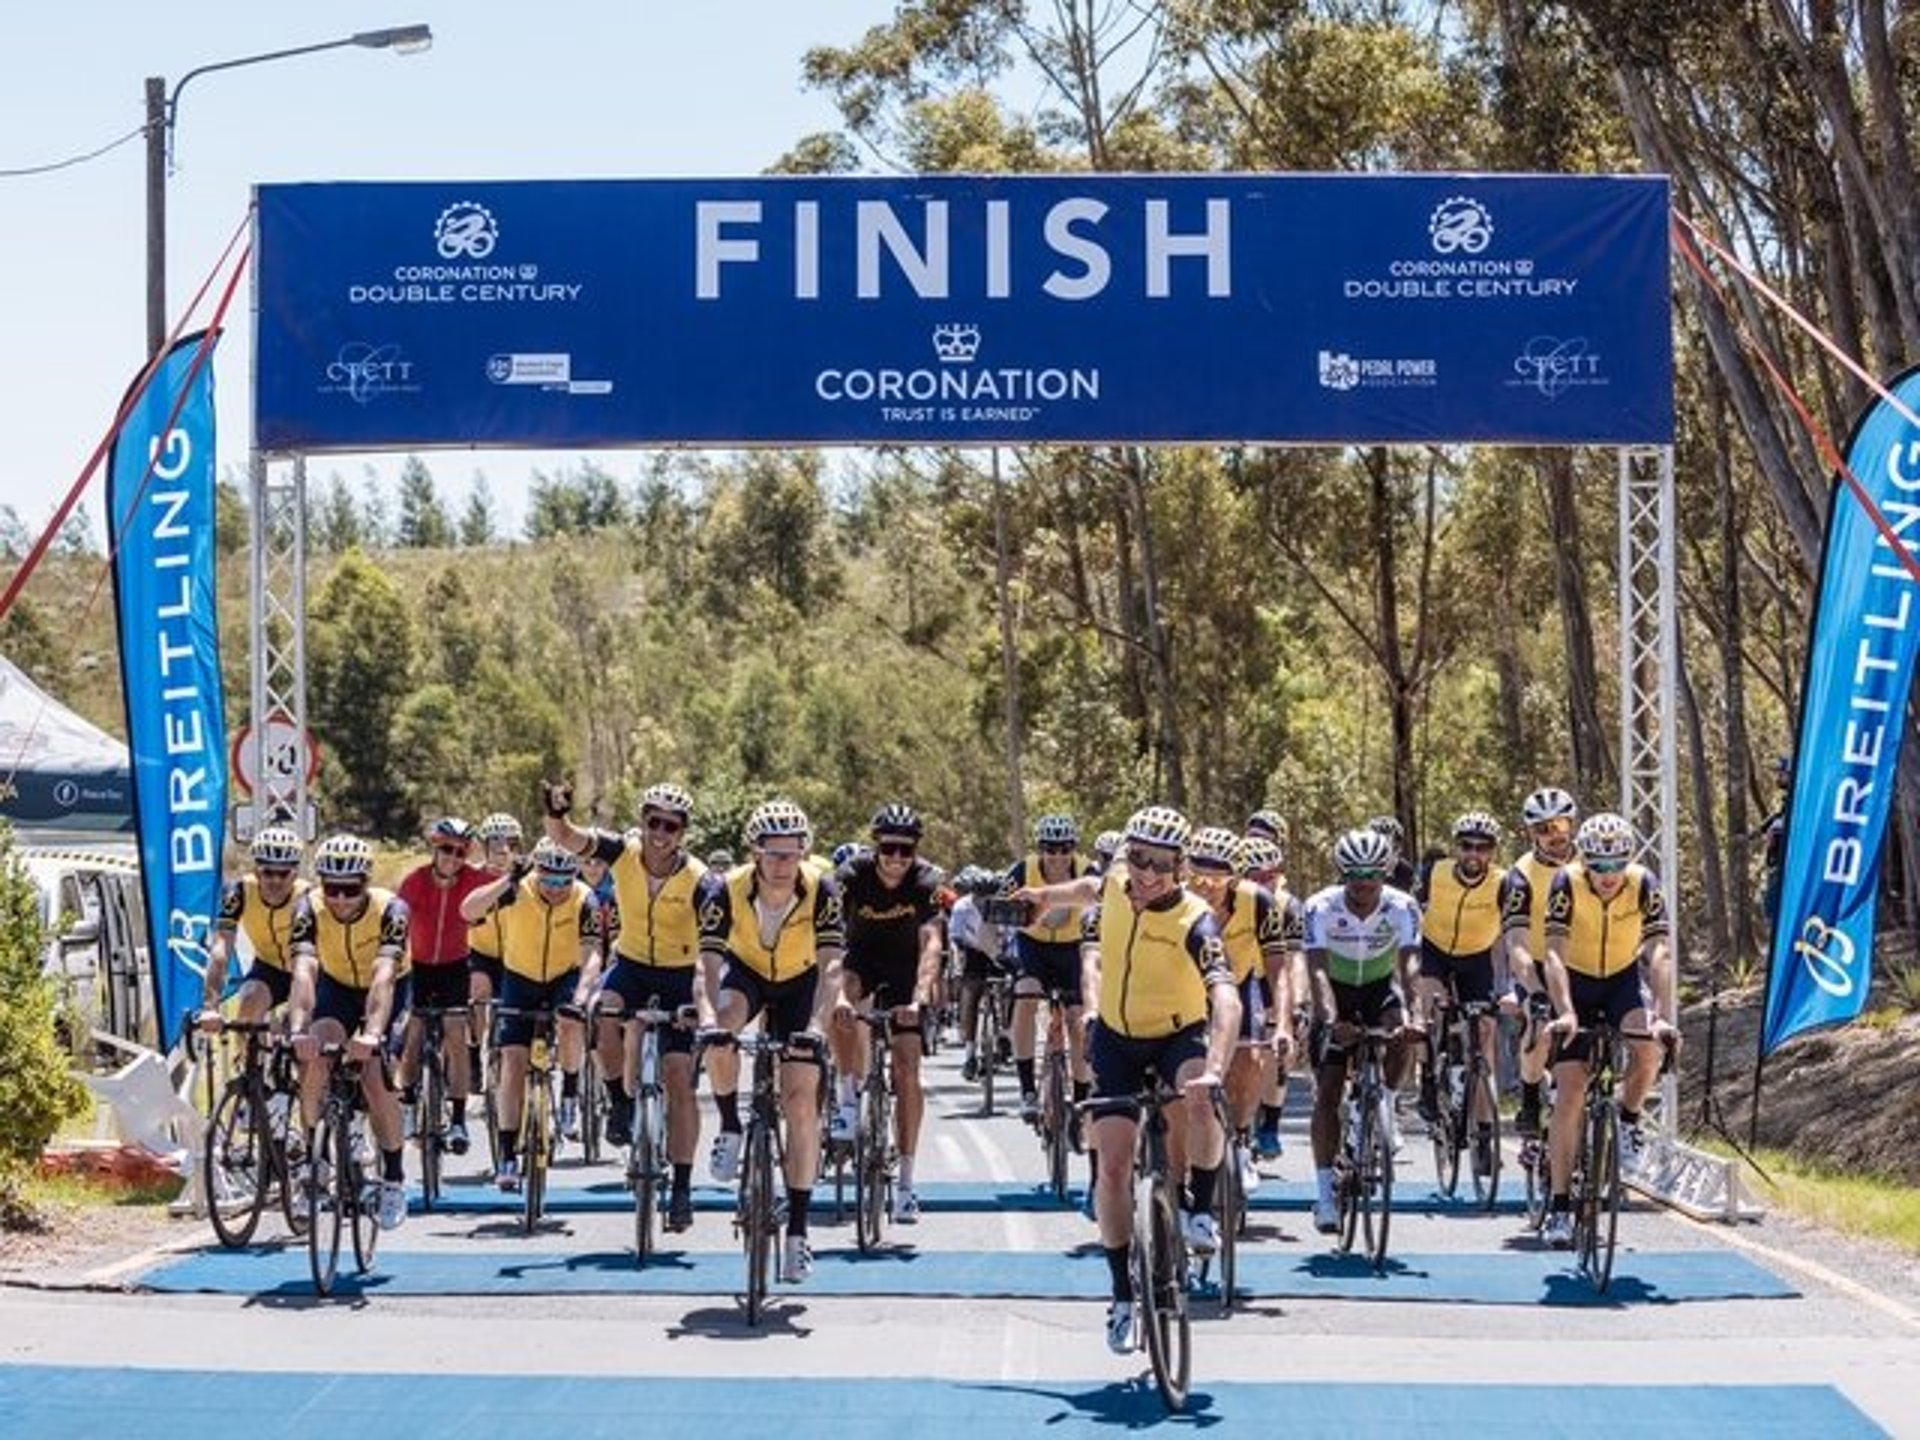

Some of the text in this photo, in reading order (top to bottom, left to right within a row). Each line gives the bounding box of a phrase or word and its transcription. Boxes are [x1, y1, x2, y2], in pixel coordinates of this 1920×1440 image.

[695, 197, 1231, 300] FINISH
[394, 265, 515, 281] CORONATION
[1389, 260, 1512, 277] CORONATION
[349, 284, 583, 303] DOUBLE CENTURY
[1343, 278, 1578, 298] DOUBLE CENTURY
[1396, 359, 1437, 376] POWER
[815, 368, 1099, 400] CORONATION
[881, 407, 934, 422] TRUST
[941, 407, 956, 422] IS
[150, 427, 214, 874] BREITLING
[1823, 440, 1920, 886] BREITLING
